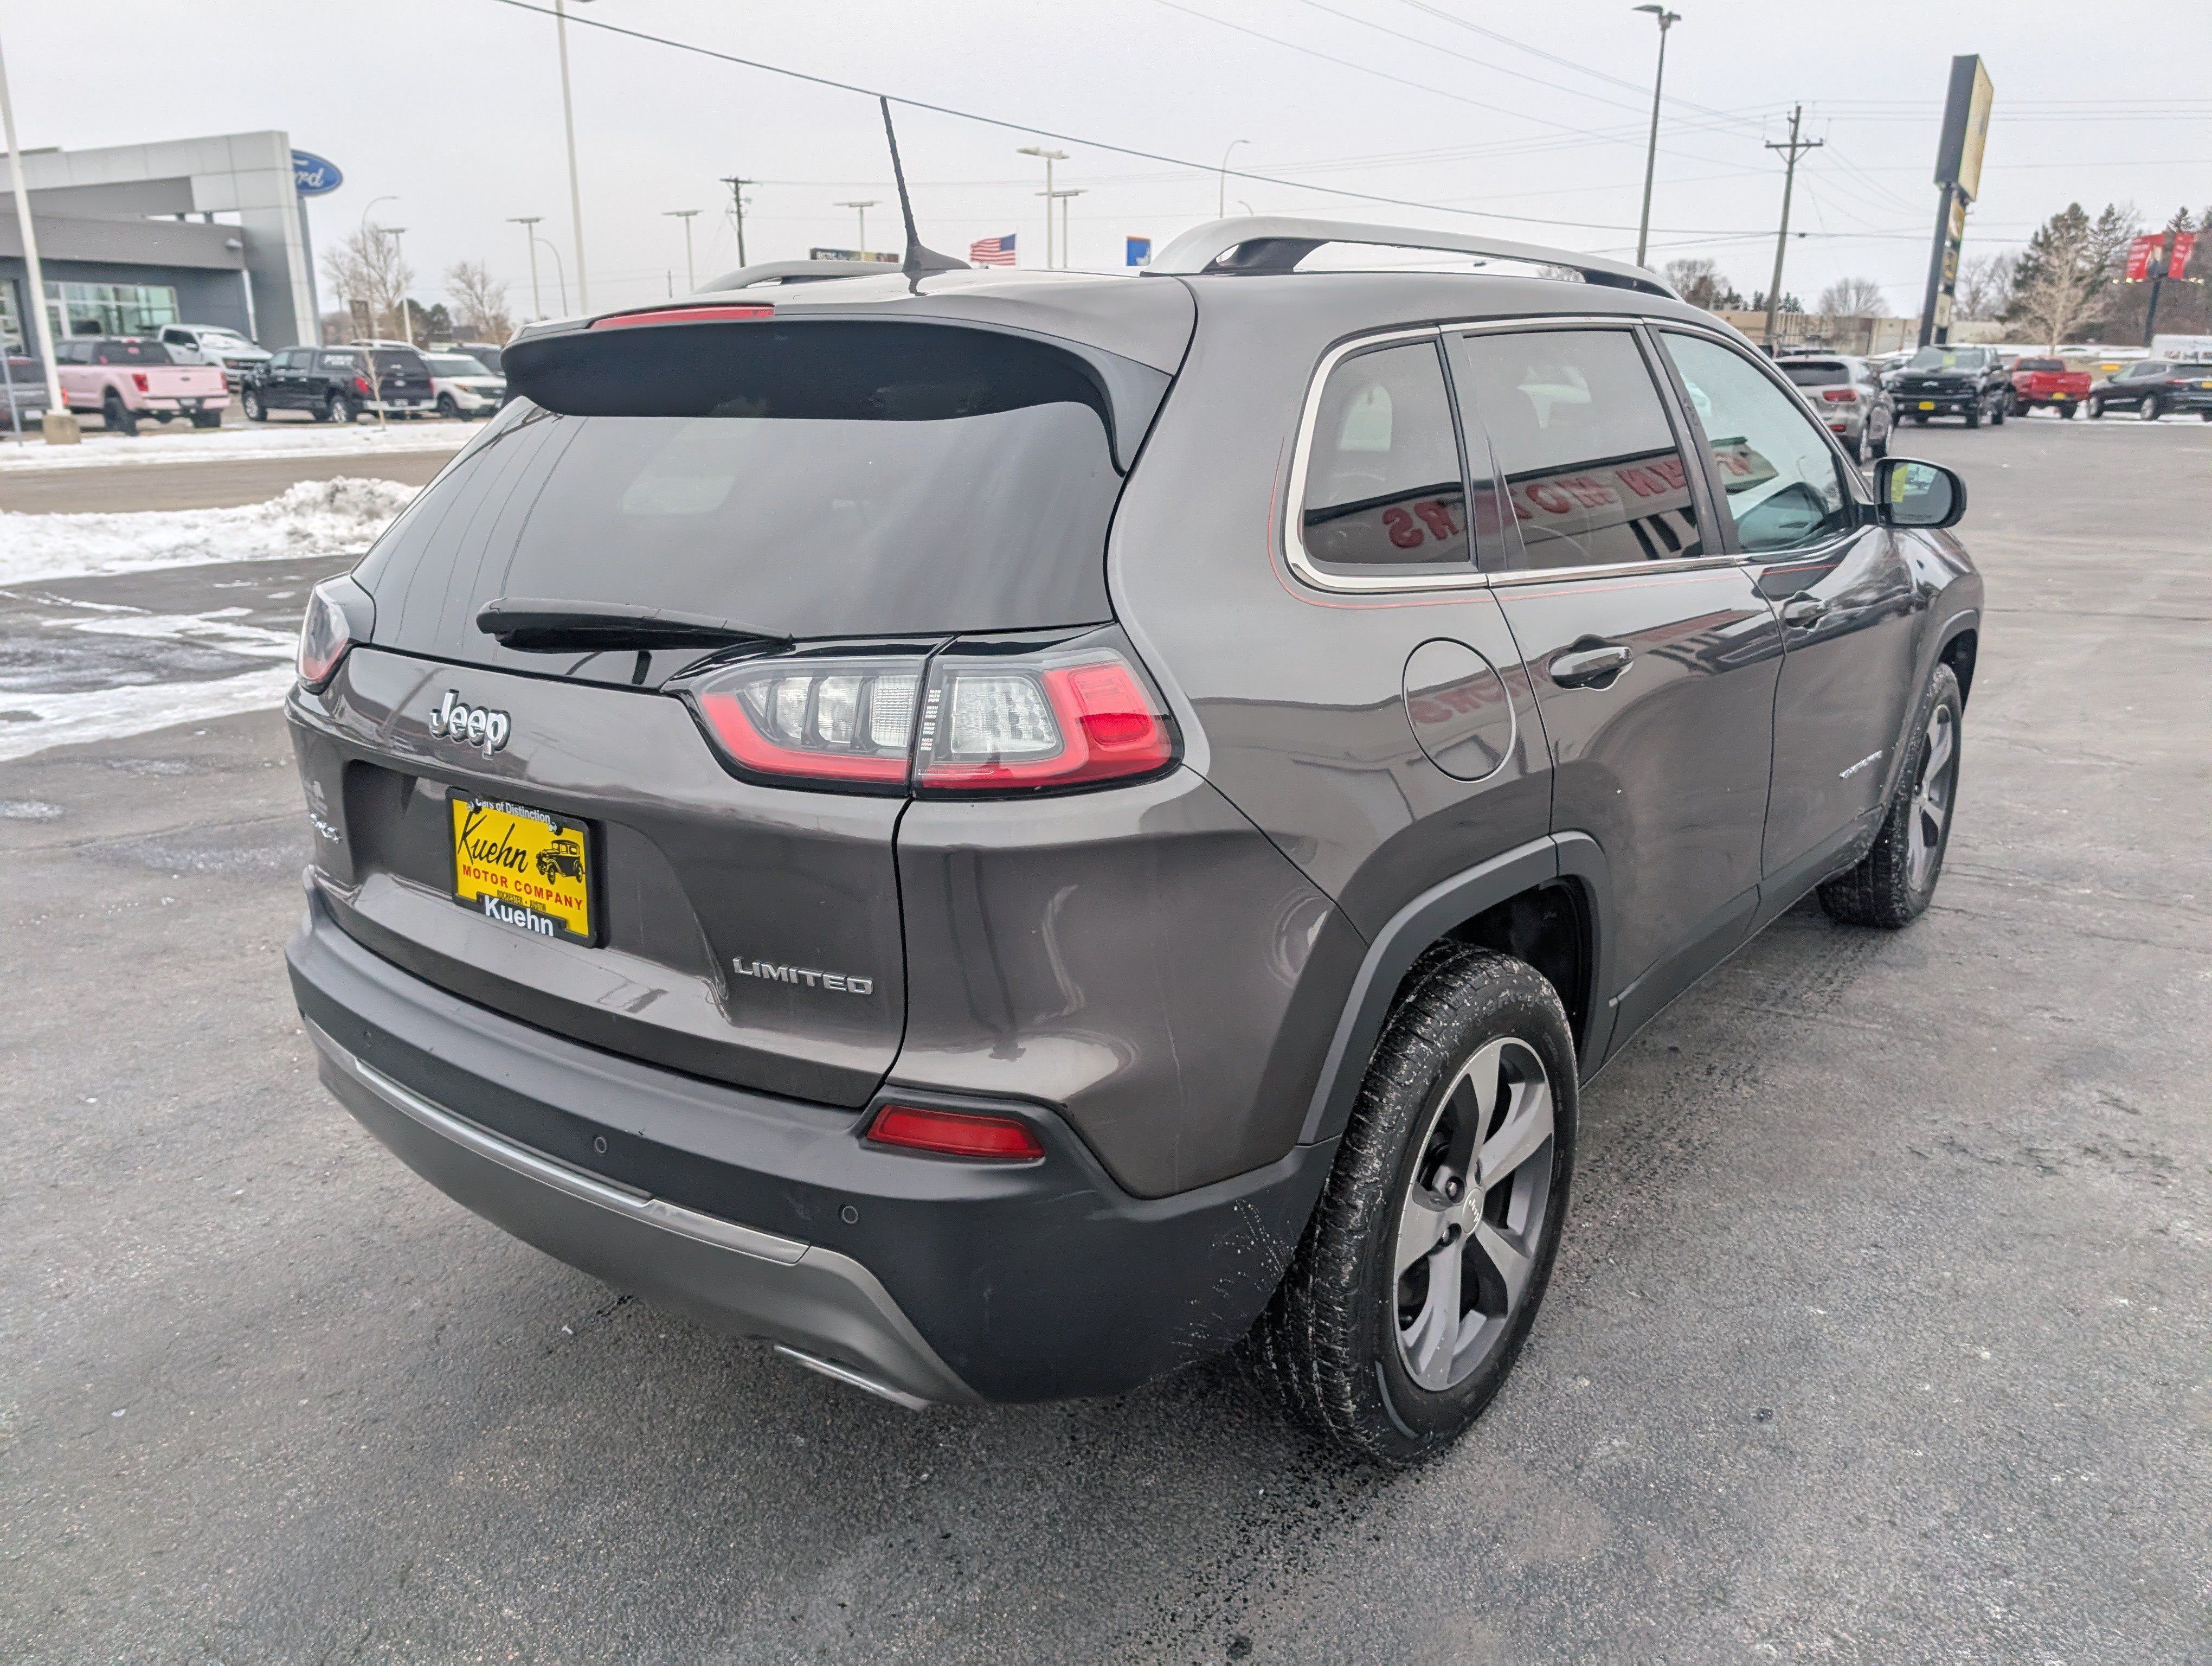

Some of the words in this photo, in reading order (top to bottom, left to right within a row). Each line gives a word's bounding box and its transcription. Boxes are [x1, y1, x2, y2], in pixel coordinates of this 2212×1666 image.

[428, 688, 511, 759] Jeep
[475, 798, 494, 810] Cars
[496, 801, 505, 812] of
[505, 802, 551, 825] Distinction
[457, 811, 529, 873] Kuehn
[462, 864, 509, 888] MOTOR
[514, 880, 583, 911] COMPANY
[496, 889, 523, 905] ROCHESTER
[529, 899, 546, 913] AUSTIN
[484, 895, 554, 937] Kuehn
[732, 956, 874, 995] LIMITED
